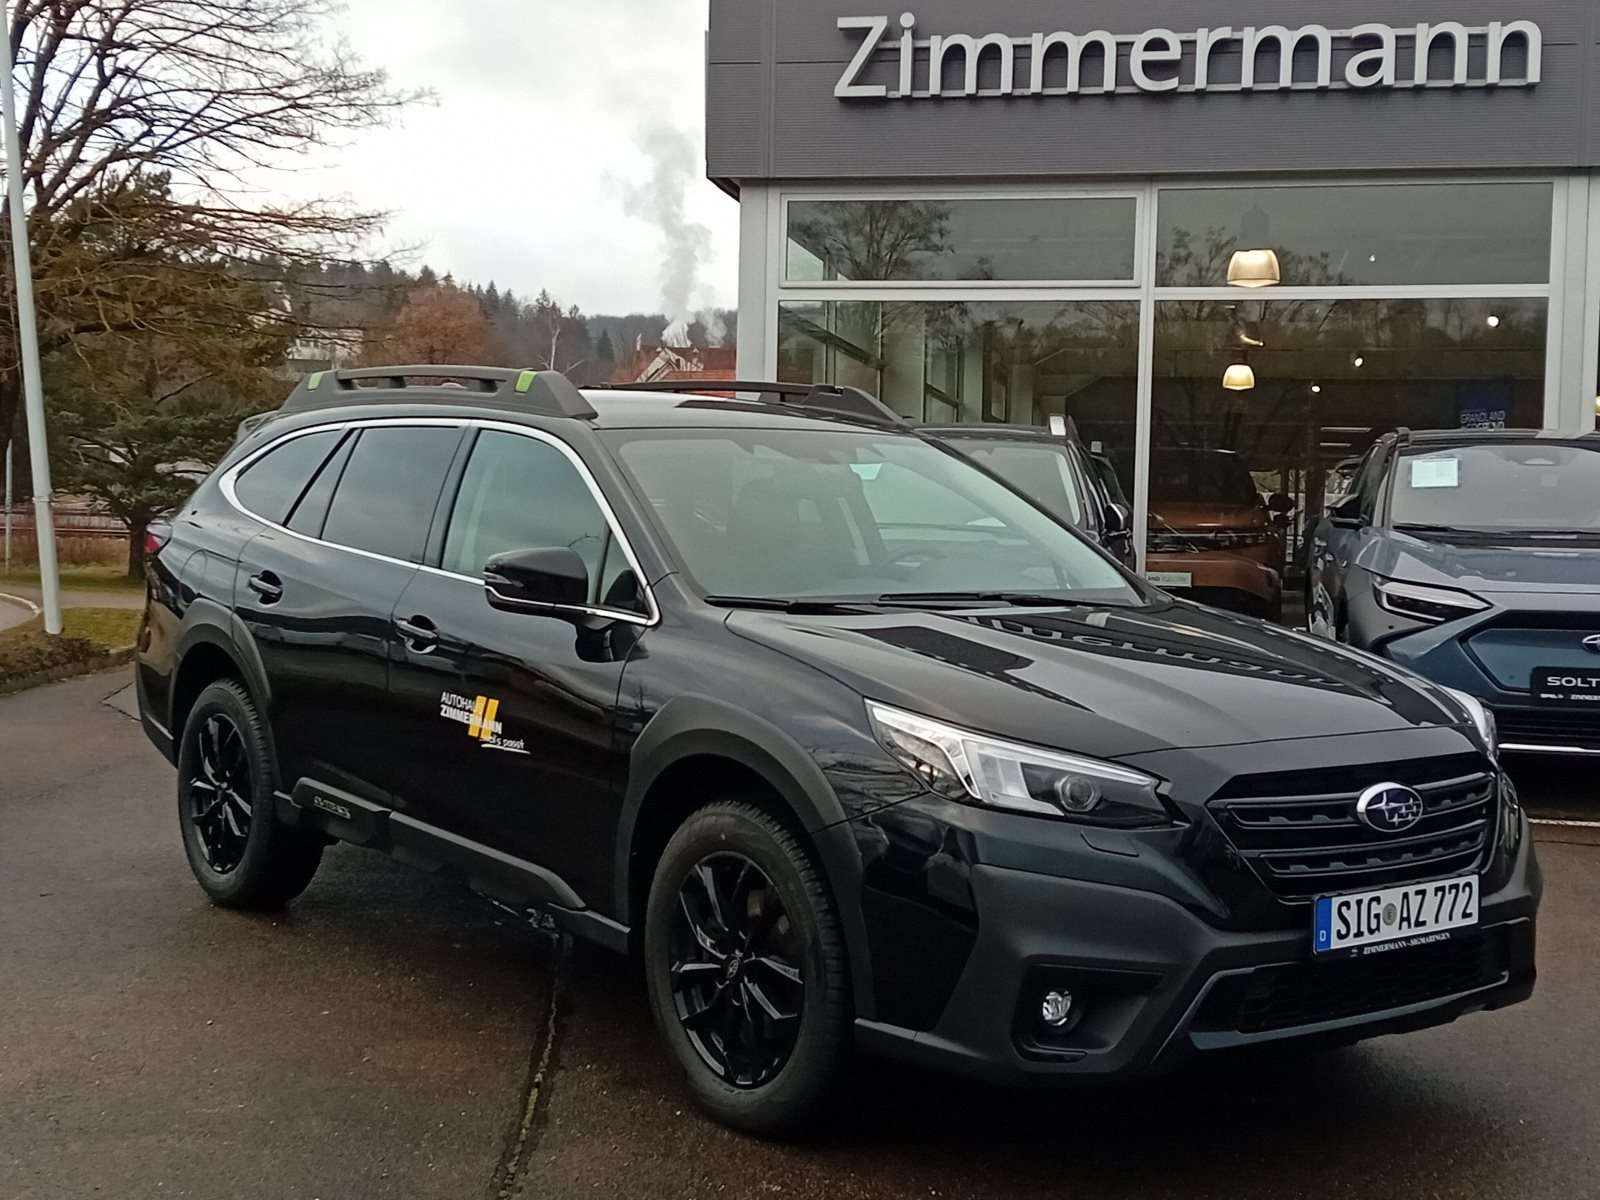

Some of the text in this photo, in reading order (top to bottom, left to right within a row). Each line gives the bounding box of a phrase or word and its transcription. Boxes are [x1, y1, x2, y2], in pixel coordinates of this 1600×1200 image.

[834, 12, 1543, 100] Zimmermann
[441, 691, 484, 713] AUTOHA
[1336, 881, 1474, 941] SIG AZ 772
